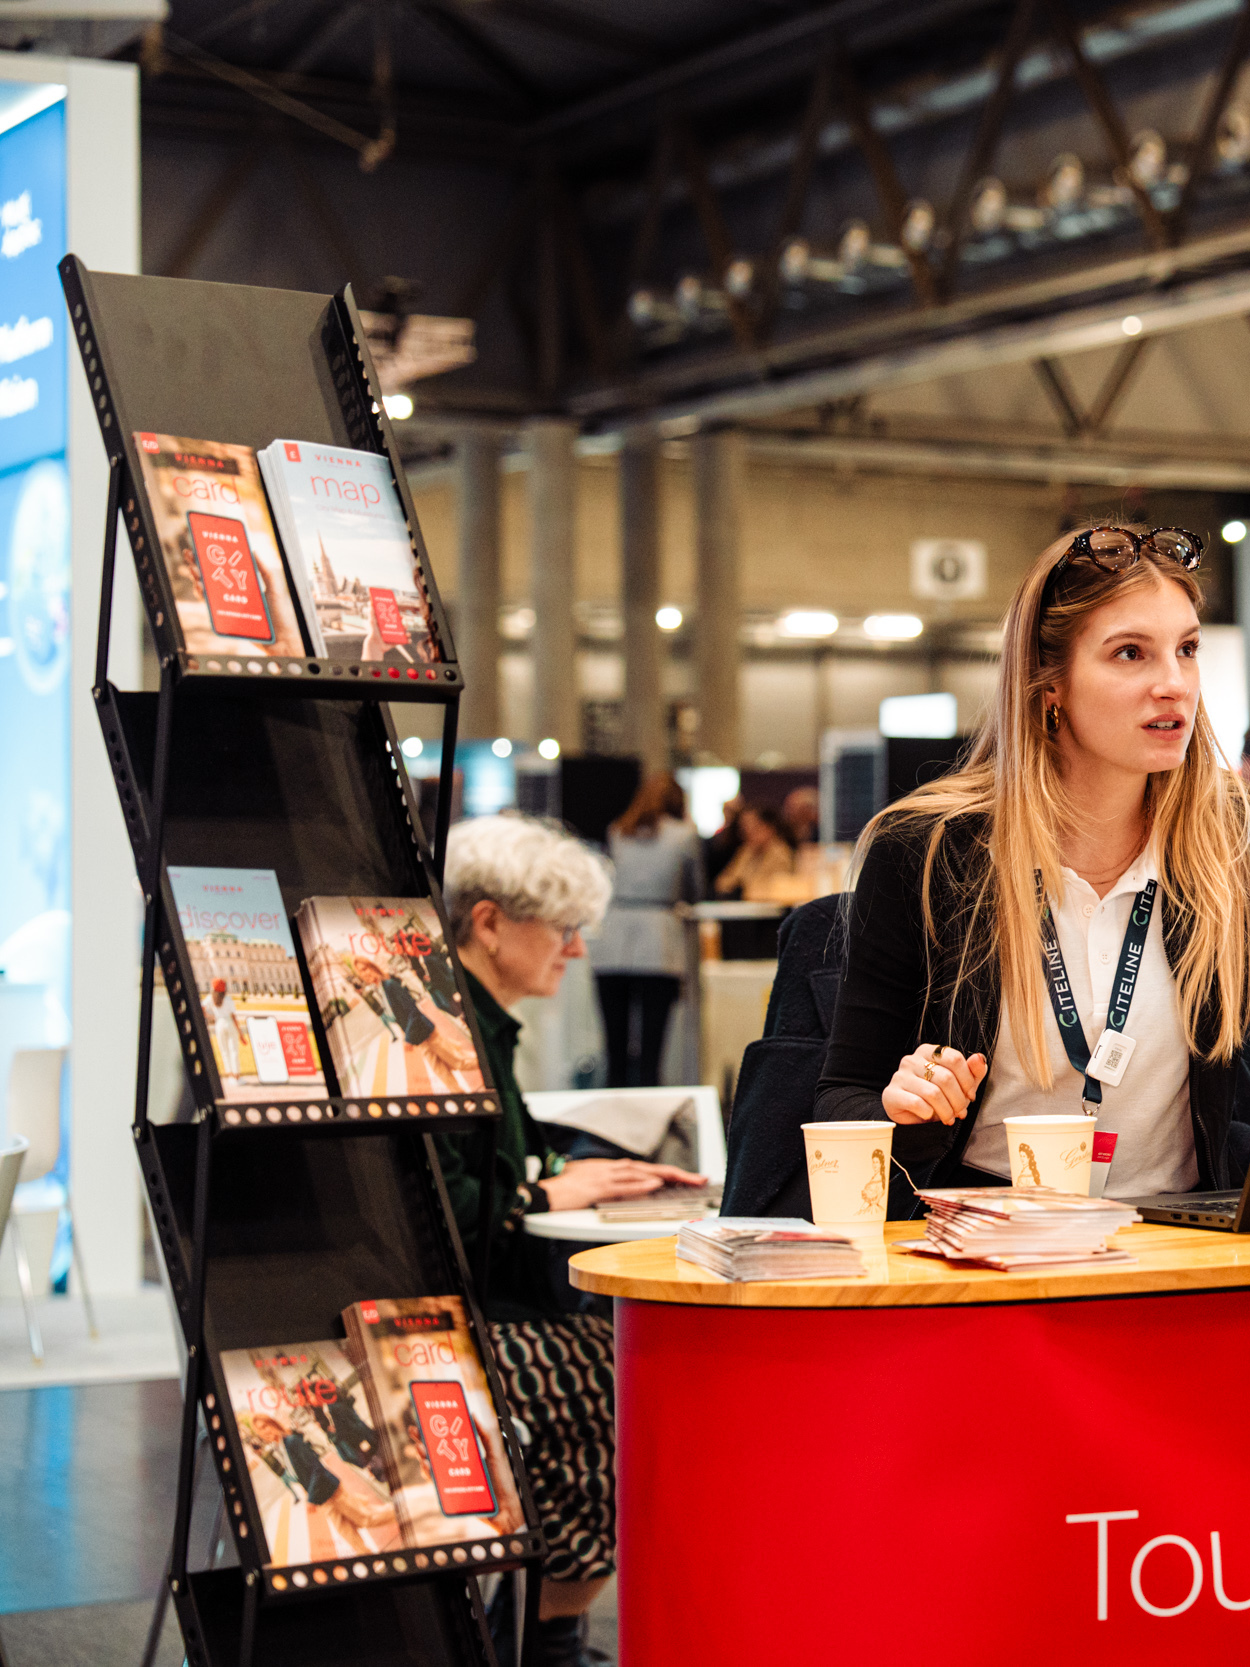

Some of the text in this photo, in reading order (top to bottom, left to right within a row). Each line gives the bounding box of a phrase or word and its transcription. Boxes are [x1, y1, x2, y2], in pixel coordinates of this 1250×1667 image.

[315, 454, 362, 467] VIENNA
[172, 475, 241, 504] card
[310, 475, 381, 508] map
[179, 904, 280, 931] discover
[348, 929, 432, 957] route
[1044, 939, 1078, 1028] CITELINE
[1109, 942, 1142, 1028] CITELINE
[394, 1331, 457, 1367] card
[246, 1377, 338, 1413] route
